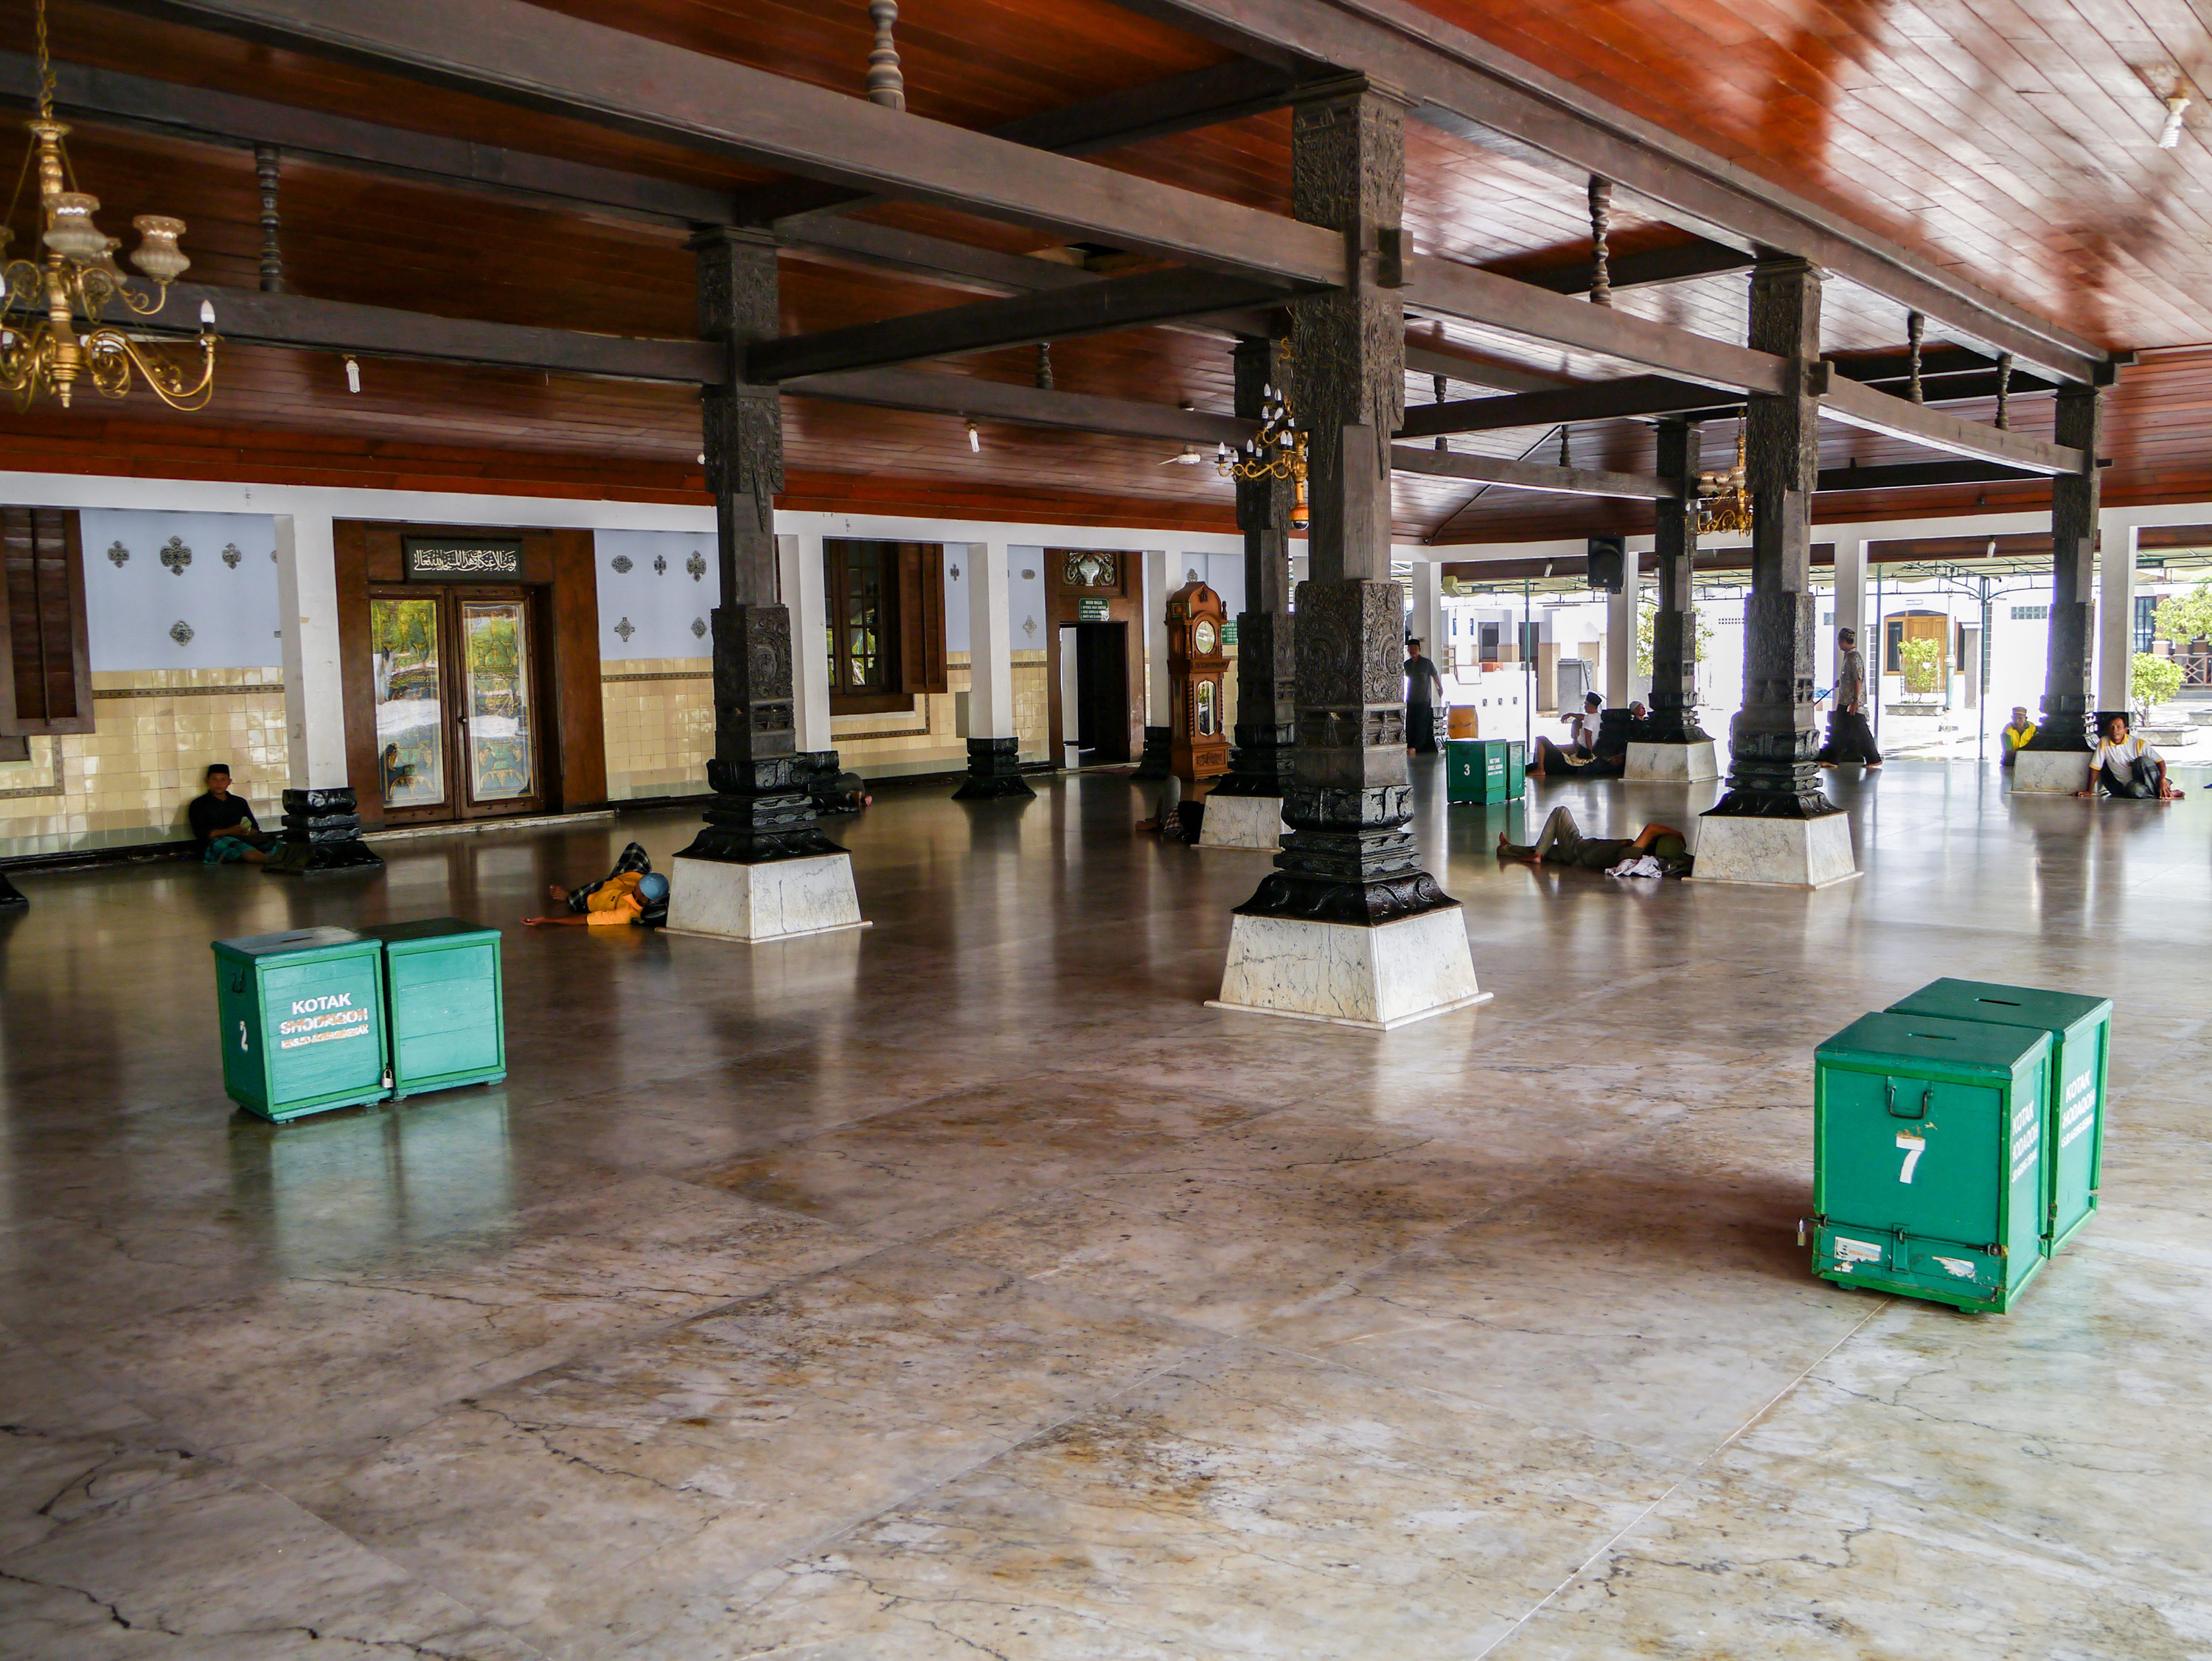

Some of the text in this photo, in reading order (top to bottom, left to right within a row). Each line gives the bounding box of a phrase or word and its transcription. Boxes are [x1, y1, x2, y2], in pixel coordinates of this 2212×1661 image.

[1464, 763, 1470, 776] 3
[292, 992, 352, 1015] KOTAK
[2065, 1069, 2091, 1104] KOTAK
[2012, 1100, 2034, 1137] KOTAK
[1896, 1136, 1925, 1184] 7
